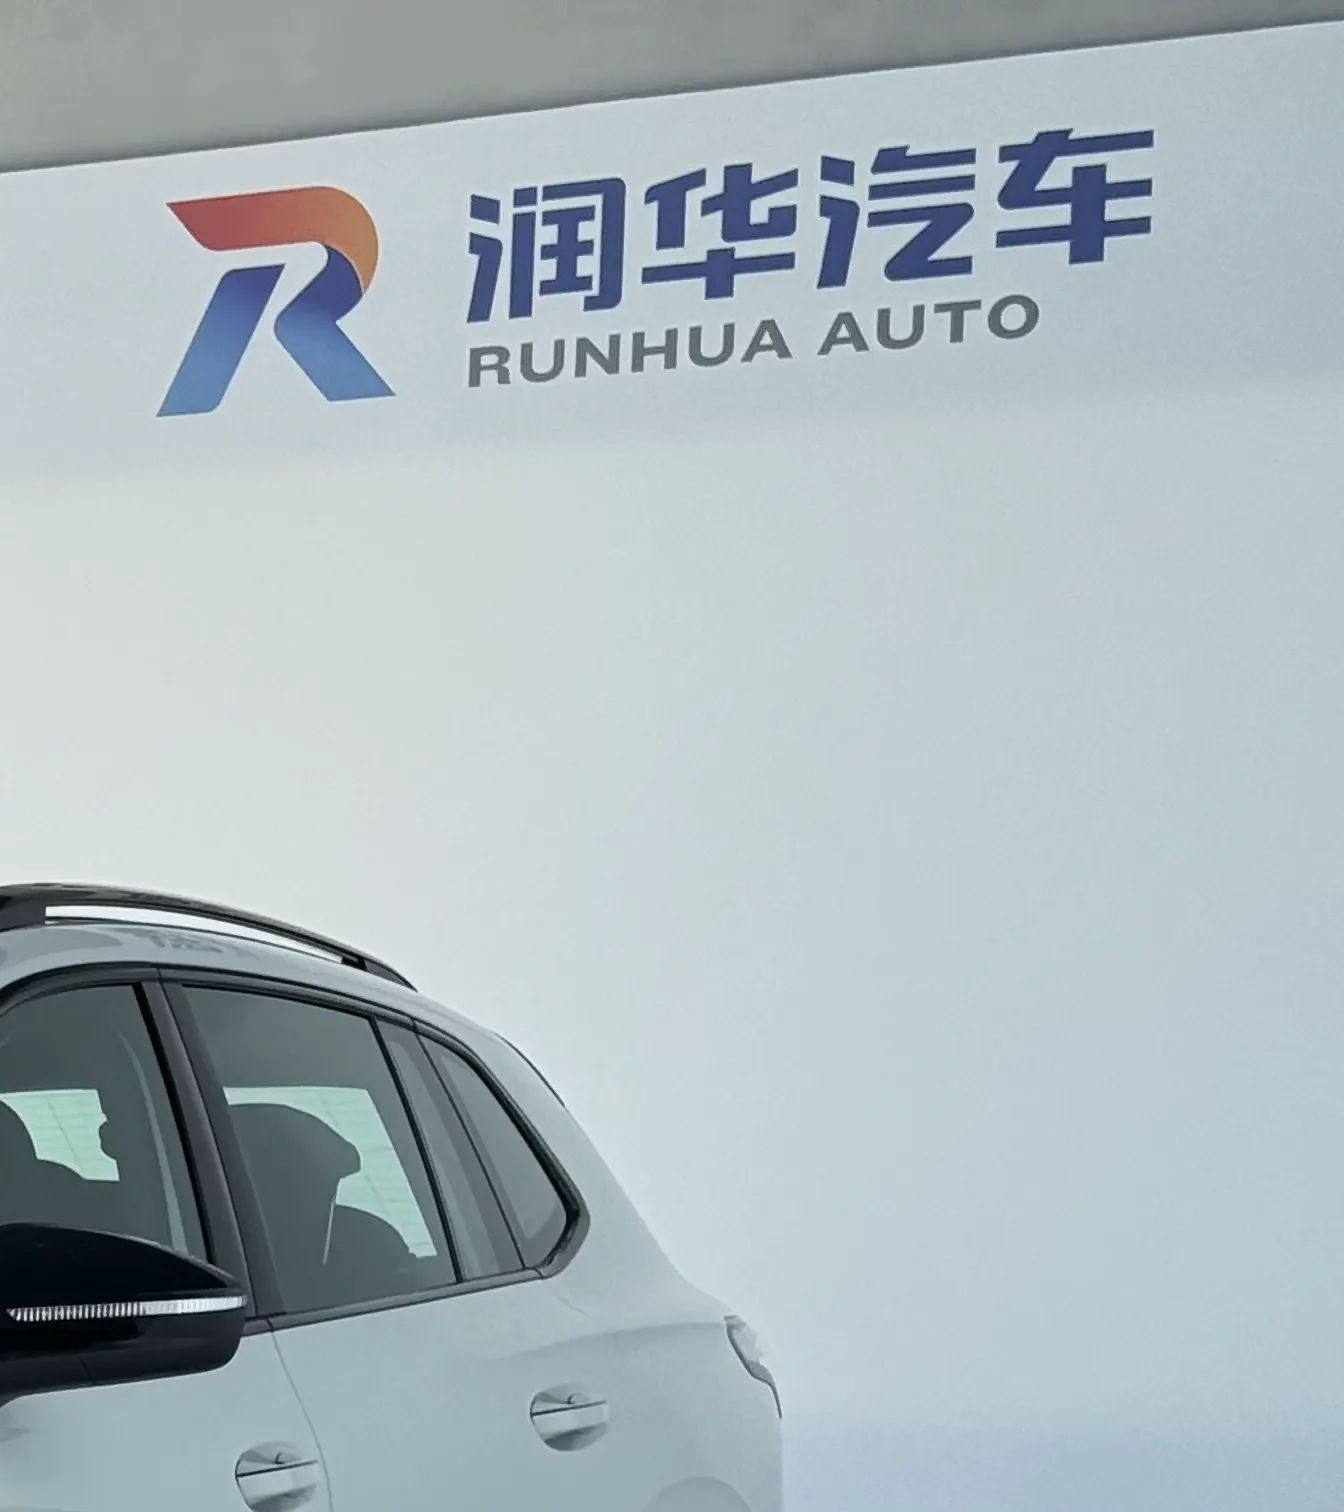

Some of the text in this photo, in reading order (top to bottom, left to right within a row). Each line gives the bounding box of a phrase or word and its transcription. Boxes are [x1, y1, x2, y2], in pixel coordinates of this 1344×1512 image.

[156, 185, 397, 418] R
[465, 127, 1155, 324] 润华汽车
[467, 294, 1040, 388] RUNHUA AUTO
